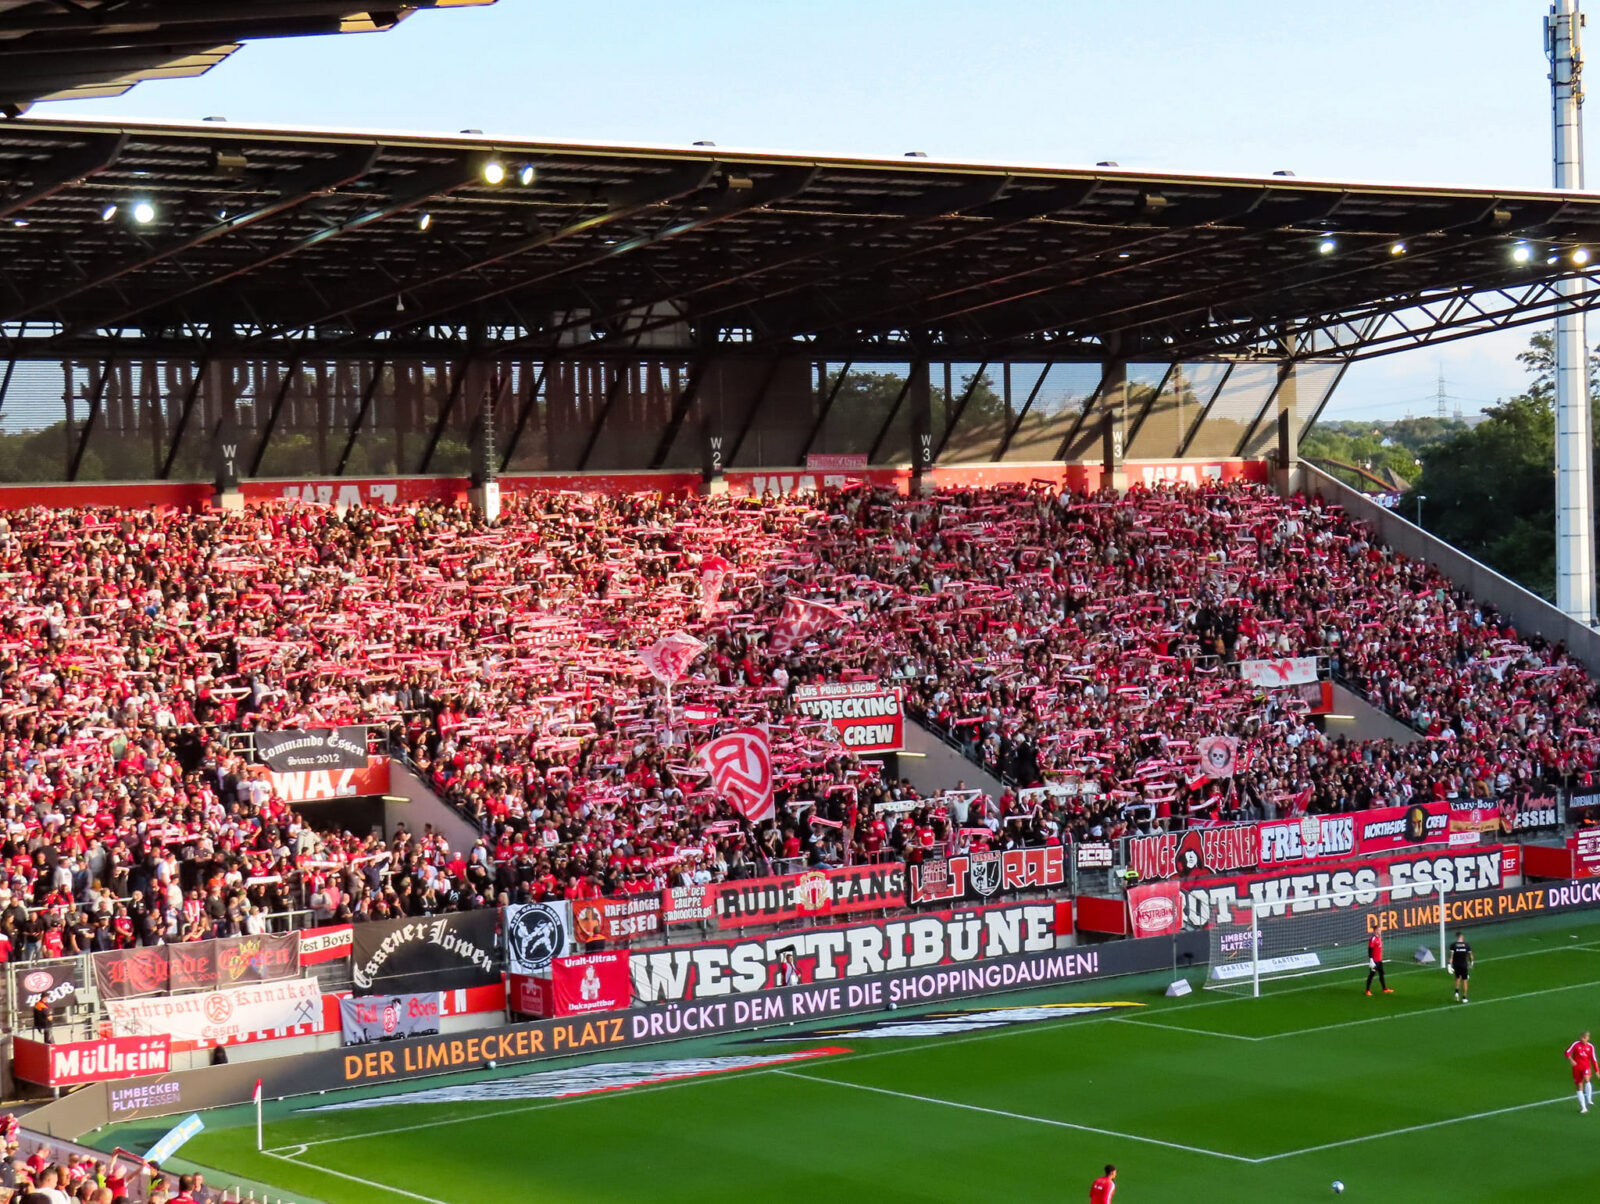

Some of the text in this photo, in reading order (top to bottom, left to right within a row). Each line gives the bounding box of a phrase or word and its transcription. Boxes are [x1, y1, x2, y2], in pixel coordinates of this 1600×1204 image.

[711, 437, 722, 449] W
[921, 434, 932, 447] W
[1113, 431, 1122, 442] W
[223, 444, 237, 458] W
[713, 451, 721, 466] 2
[923, 448, 930, 462] 3
[1114, 444, 1121, 457] 3
[226, 461, 233, 476] 1
[801, 696, 898, 719] WRECKING
[844, 725, 893, 746] CREW
[260, 734, 364, 760] Commando Essen
[316, 754, 340, 763] 2012
[1364, 814, 1448, 839] NORTHSIDE CREW
[1514, 810, 1556, 829] ESSEN
[1130, 834, 1177, 881] JUNGE
[1204, 825, 1258, 870] ESSENER
[1389, 852, 1501, 899] ESSEN
[721, 884, 797, 919] RUDE
[830, 871, 903, 907] FANS
[1367, 911, 1399, 933] DER
[1404, 898, 1494, 928] LIMBECKER
[1499, 890, 1544, 914] PLATZ
[610, 914, 657, 936] ESSEN
[322, 934, 350, 949] Boys
[1220, 930, 1262, 943] LIMBECKR
[354, 919, 492, 988] Essener Löwen
[564, 954, 617, 968] Uralt-Ultras
[233, 983, 317, 1006] Kanaken
[345, 952, 1100, 1080] DER LIMBECKER PLATZ DRÜCKT DEM RWE DIE SHOPPINGDAUMEN!
[201, 1024, 240, 1038] Essen
[112, 1081, 180, 1101] LIMBECKER
[113, 1097, 149, 1112] PLATZ
